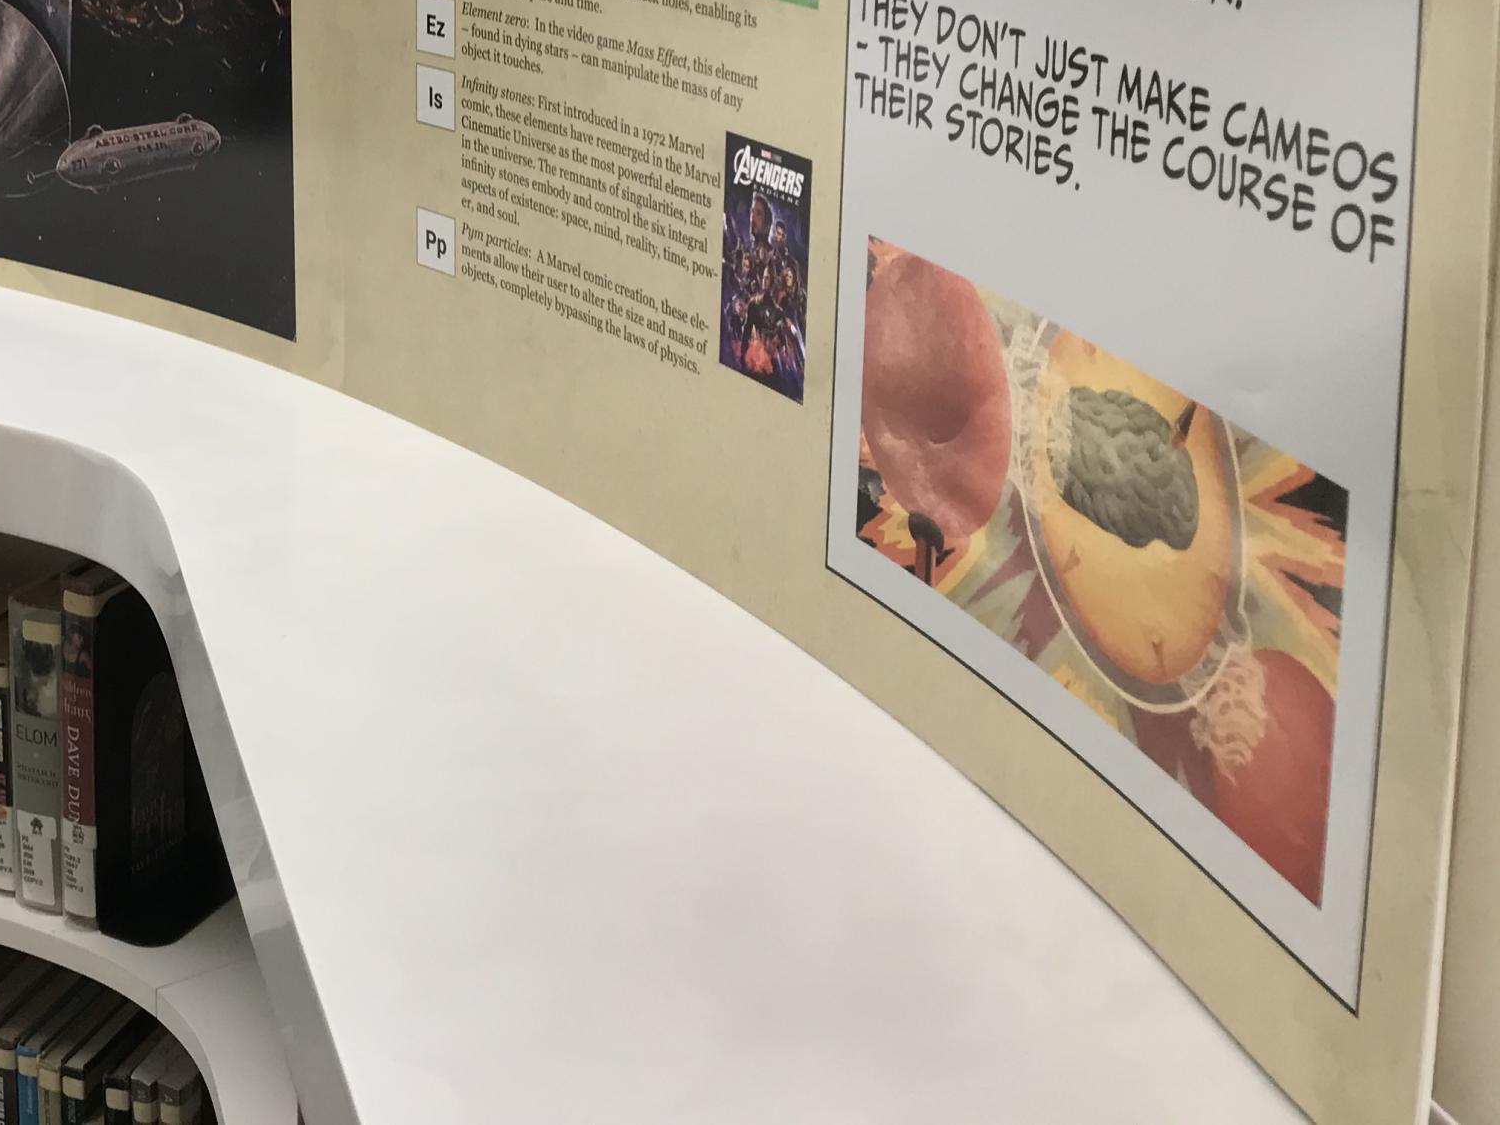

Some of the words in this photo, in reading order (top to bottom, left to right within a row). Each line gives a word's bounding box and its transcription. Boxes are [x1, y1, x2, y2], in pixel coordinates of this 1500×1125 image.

[426, 13, 446, 38] Ez
[429, 85, 443, 110] Is
[937, 6, 1026, 69] DON'T
[1035, 35, 1109, 97] JUST
[1117, 64, 1211, 132] MAKE
[1223, 101, 1398, 203] CAMEOS
[855, 72, 933, 130] THEIR
[945, 103, 1080, 191] STORIES.
[878, 35, 950, 89] THEY
[959, 62, 1080, 136] CHANGE
[1092, 106, 1150, 163] THE
[1162, 136, 1316, 232] COURSE
[1331, 203, 1395, 264] OF
[733, 144, 805, 197] AVENGERS
[425, 228, 447, 259] Pp
[16, 724, 58, 748] ELOM
[67, 725, 81, 778] DAVE
